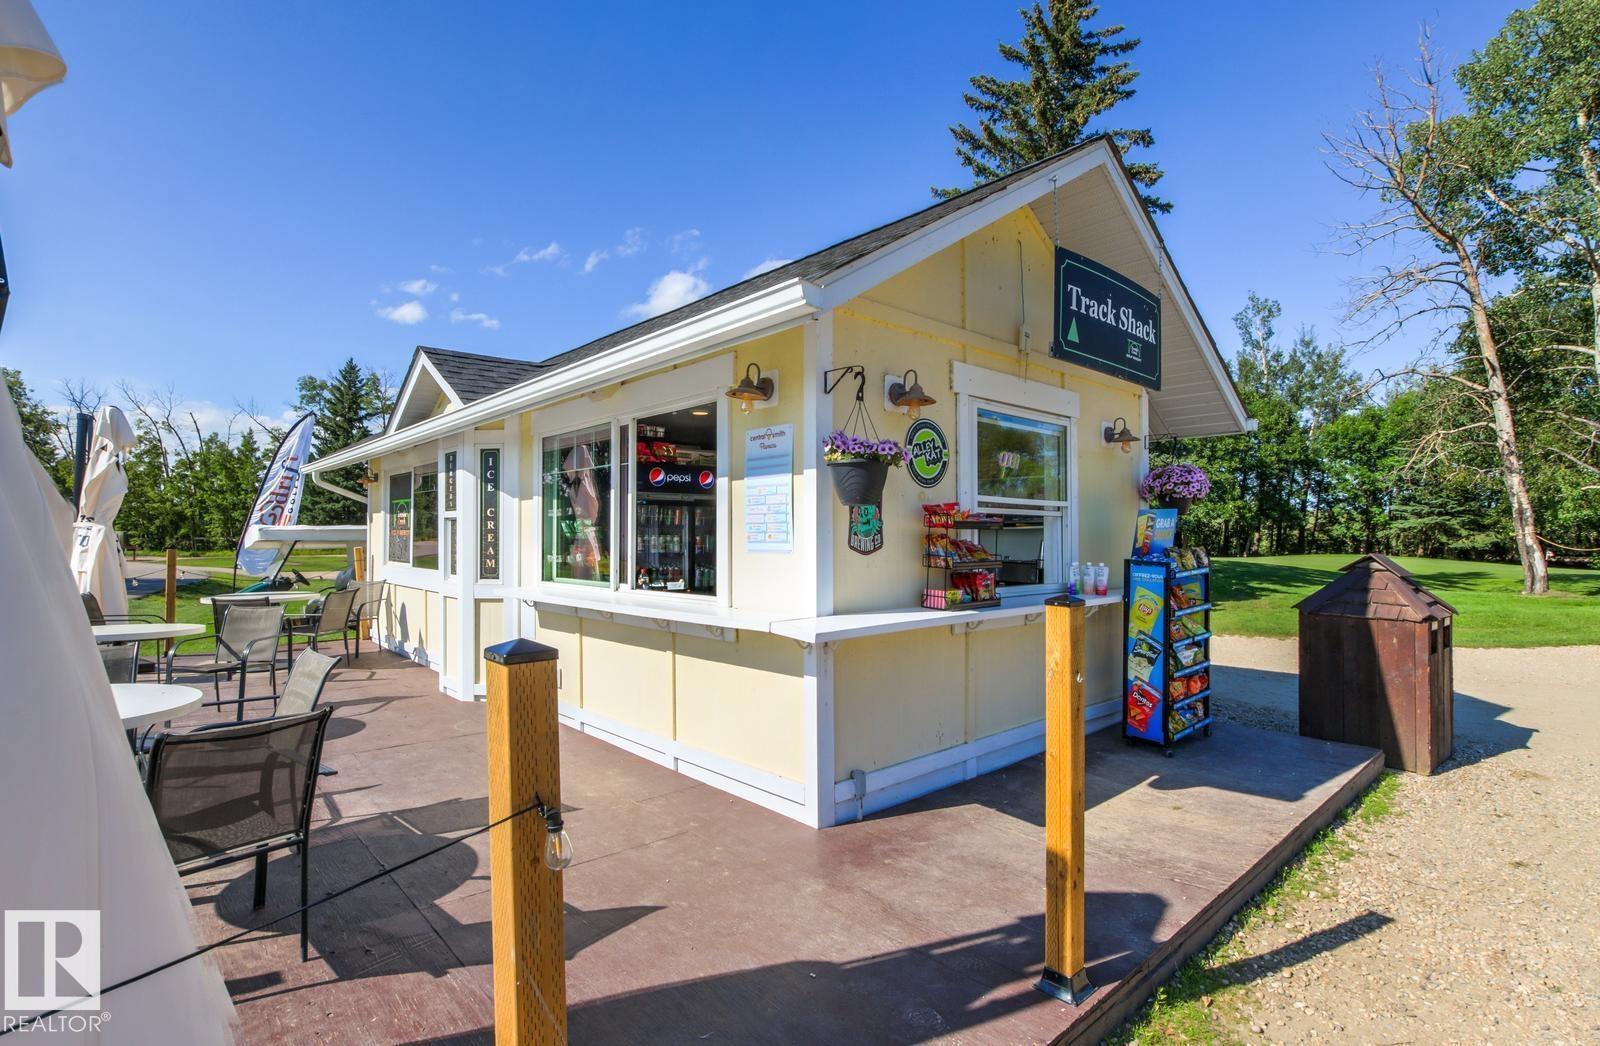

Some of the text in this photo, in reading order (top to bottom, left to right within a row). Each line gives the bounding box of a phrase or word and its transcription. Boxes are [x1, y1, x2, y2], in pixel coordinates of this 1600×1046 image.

[1067, 284, 1156, 345] Track Shack
[912, 438, 936, 458] ALLEY
[925, 449, 942, 462] KAT
[486, 457, 495, 492] ICE
[666, 473, 692, 484] pepsi
[485, 507, 496, 568] CREAM
[1132, 691, 1153, 708] Doritos
